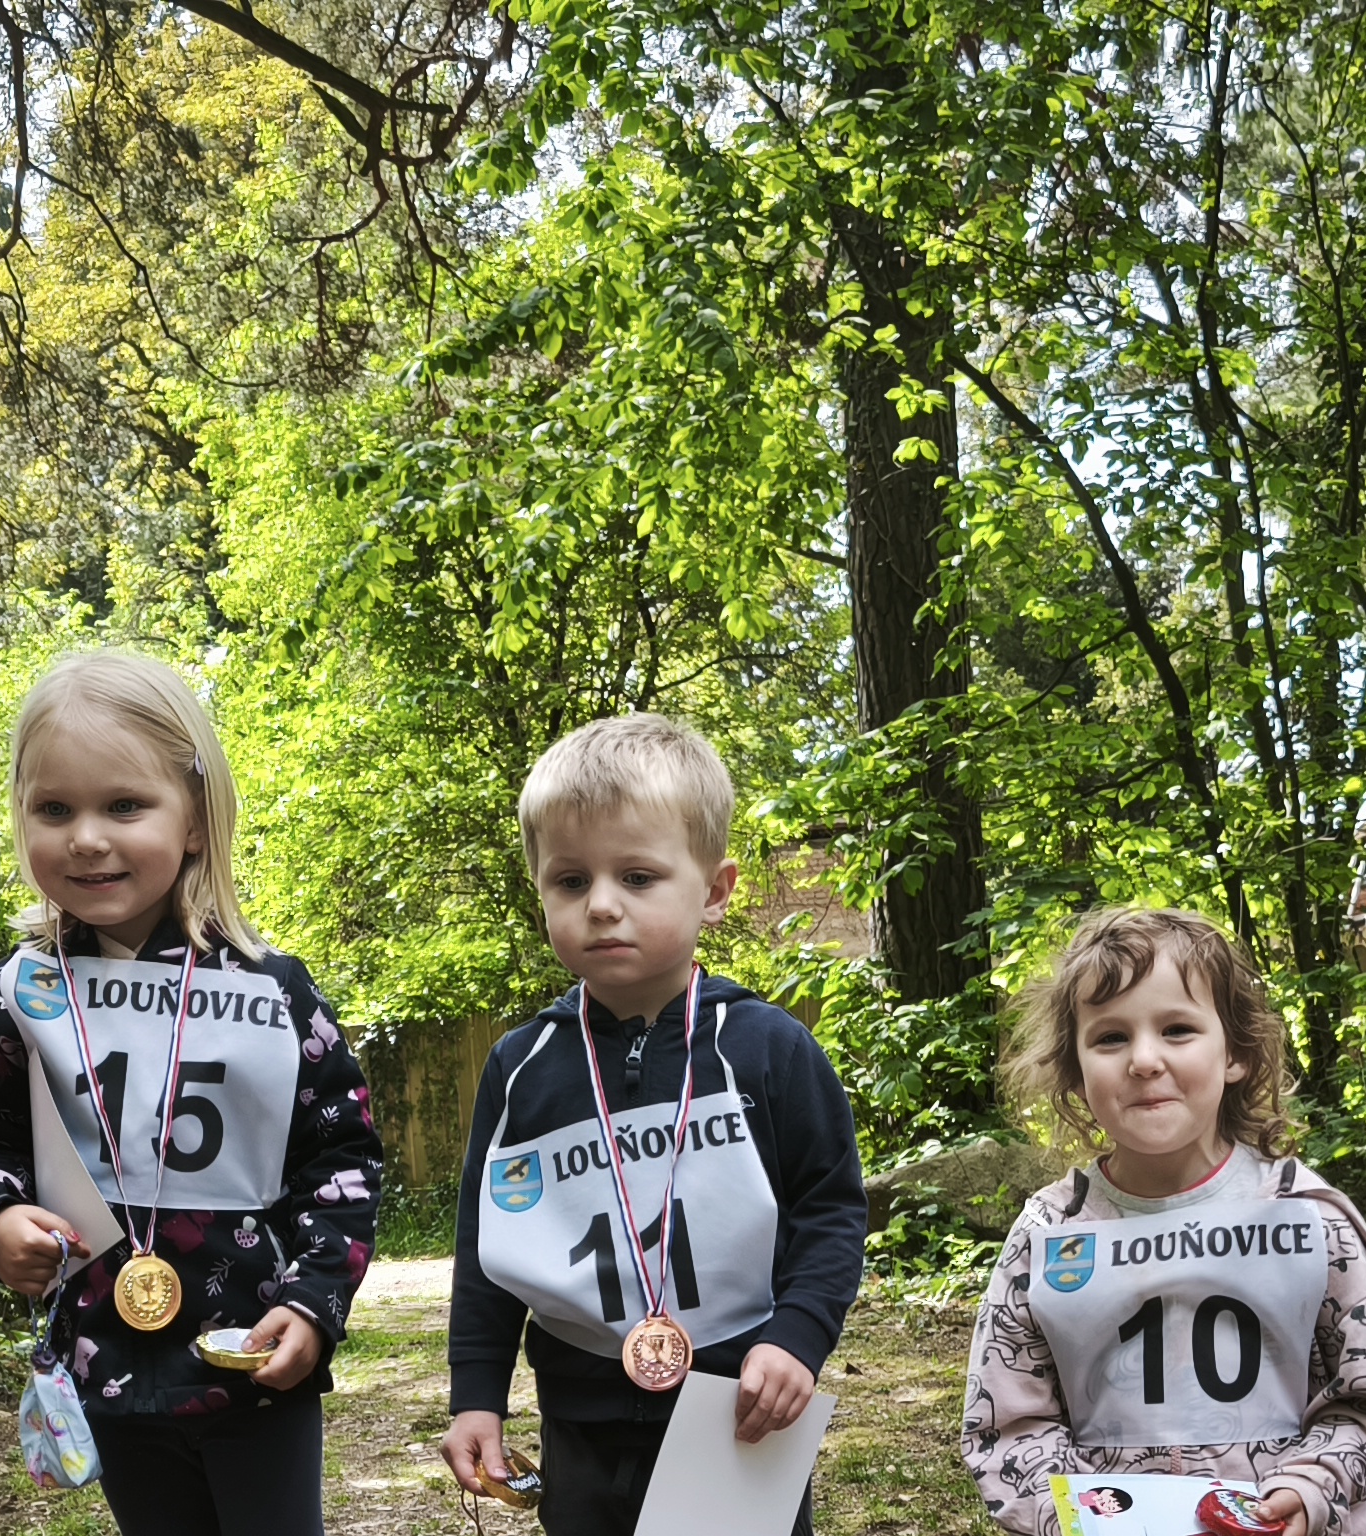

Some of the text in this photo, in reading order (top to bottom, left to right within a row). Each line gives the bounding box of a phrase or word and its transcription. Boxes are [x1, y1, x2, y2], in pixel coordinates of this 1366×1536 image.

[75, 1050, 227, 1173] 15
[569, 1198, 701, 1323] 11
[1111, 1222, 1314, 1267] LOUŇOVICE
[1118, 1294, 1262, 1405] 10
